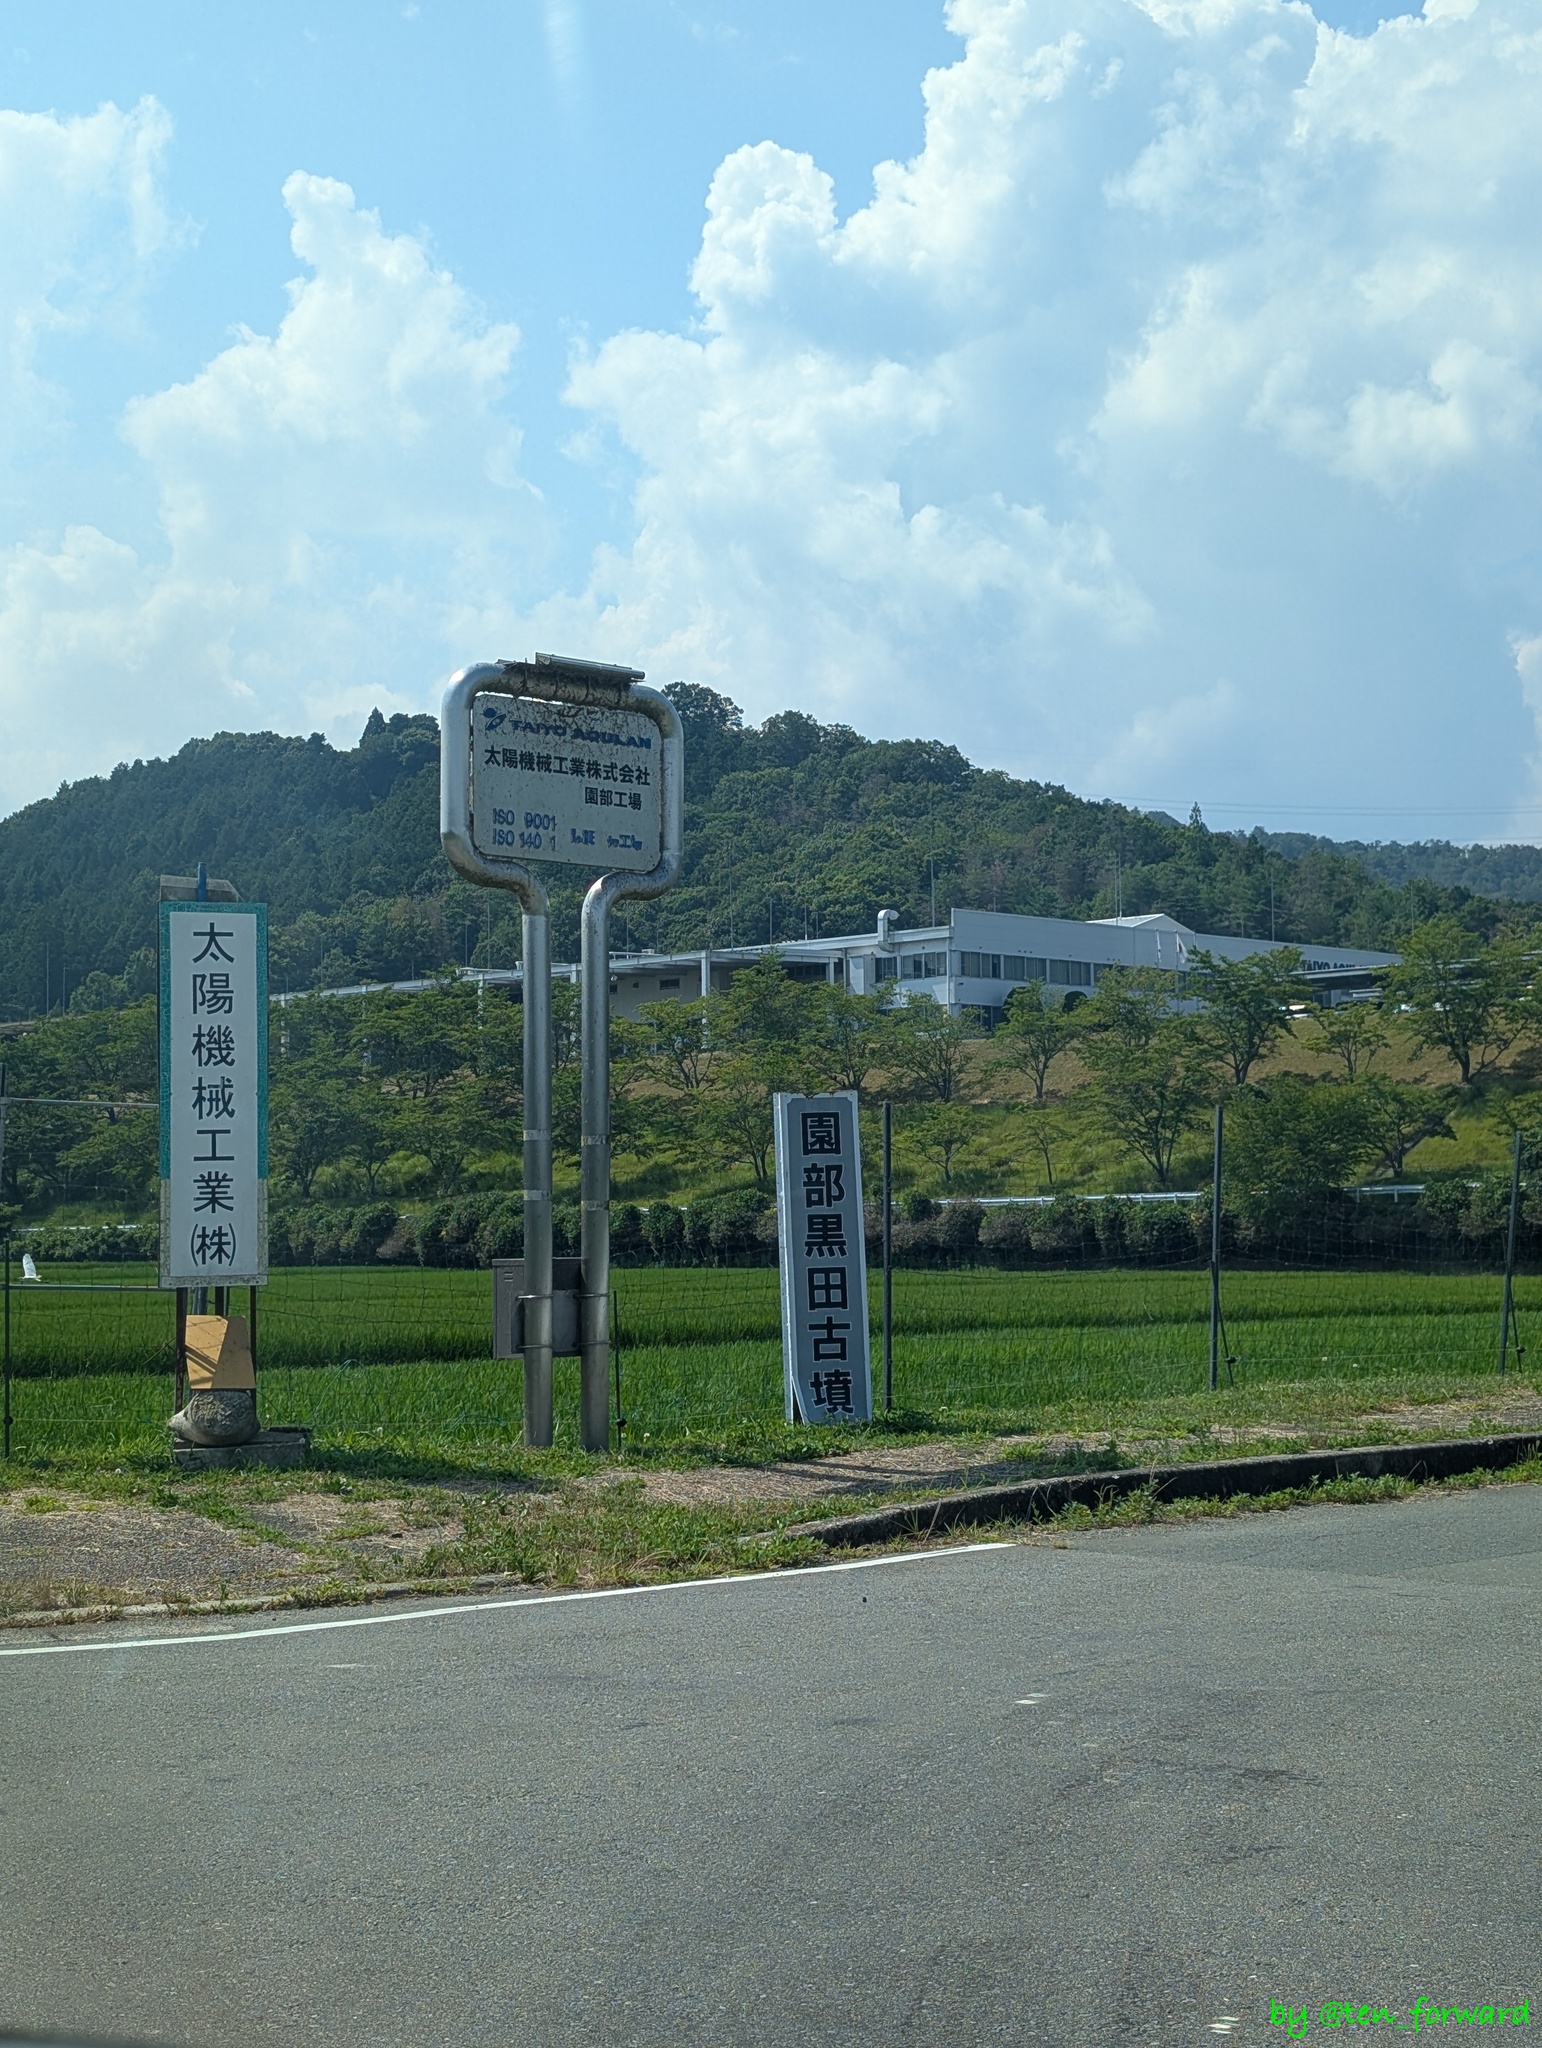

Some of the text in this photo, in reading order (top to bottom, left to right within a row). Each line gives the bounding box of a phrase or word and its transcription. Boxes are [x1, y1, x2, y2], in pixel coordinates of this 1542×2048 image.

[509, 719, 652, 749] TAIYO AQULAN
[484, 745, 651, 786] 太陽機械工業株式会社
[584, 786, 642, 811] 園部工場
[492, 807, 557, 832] ISO 9001
[492, 828, 556, 851] ISO 1401
[801, 1111, 855, 1415] 園部黒田古墳
